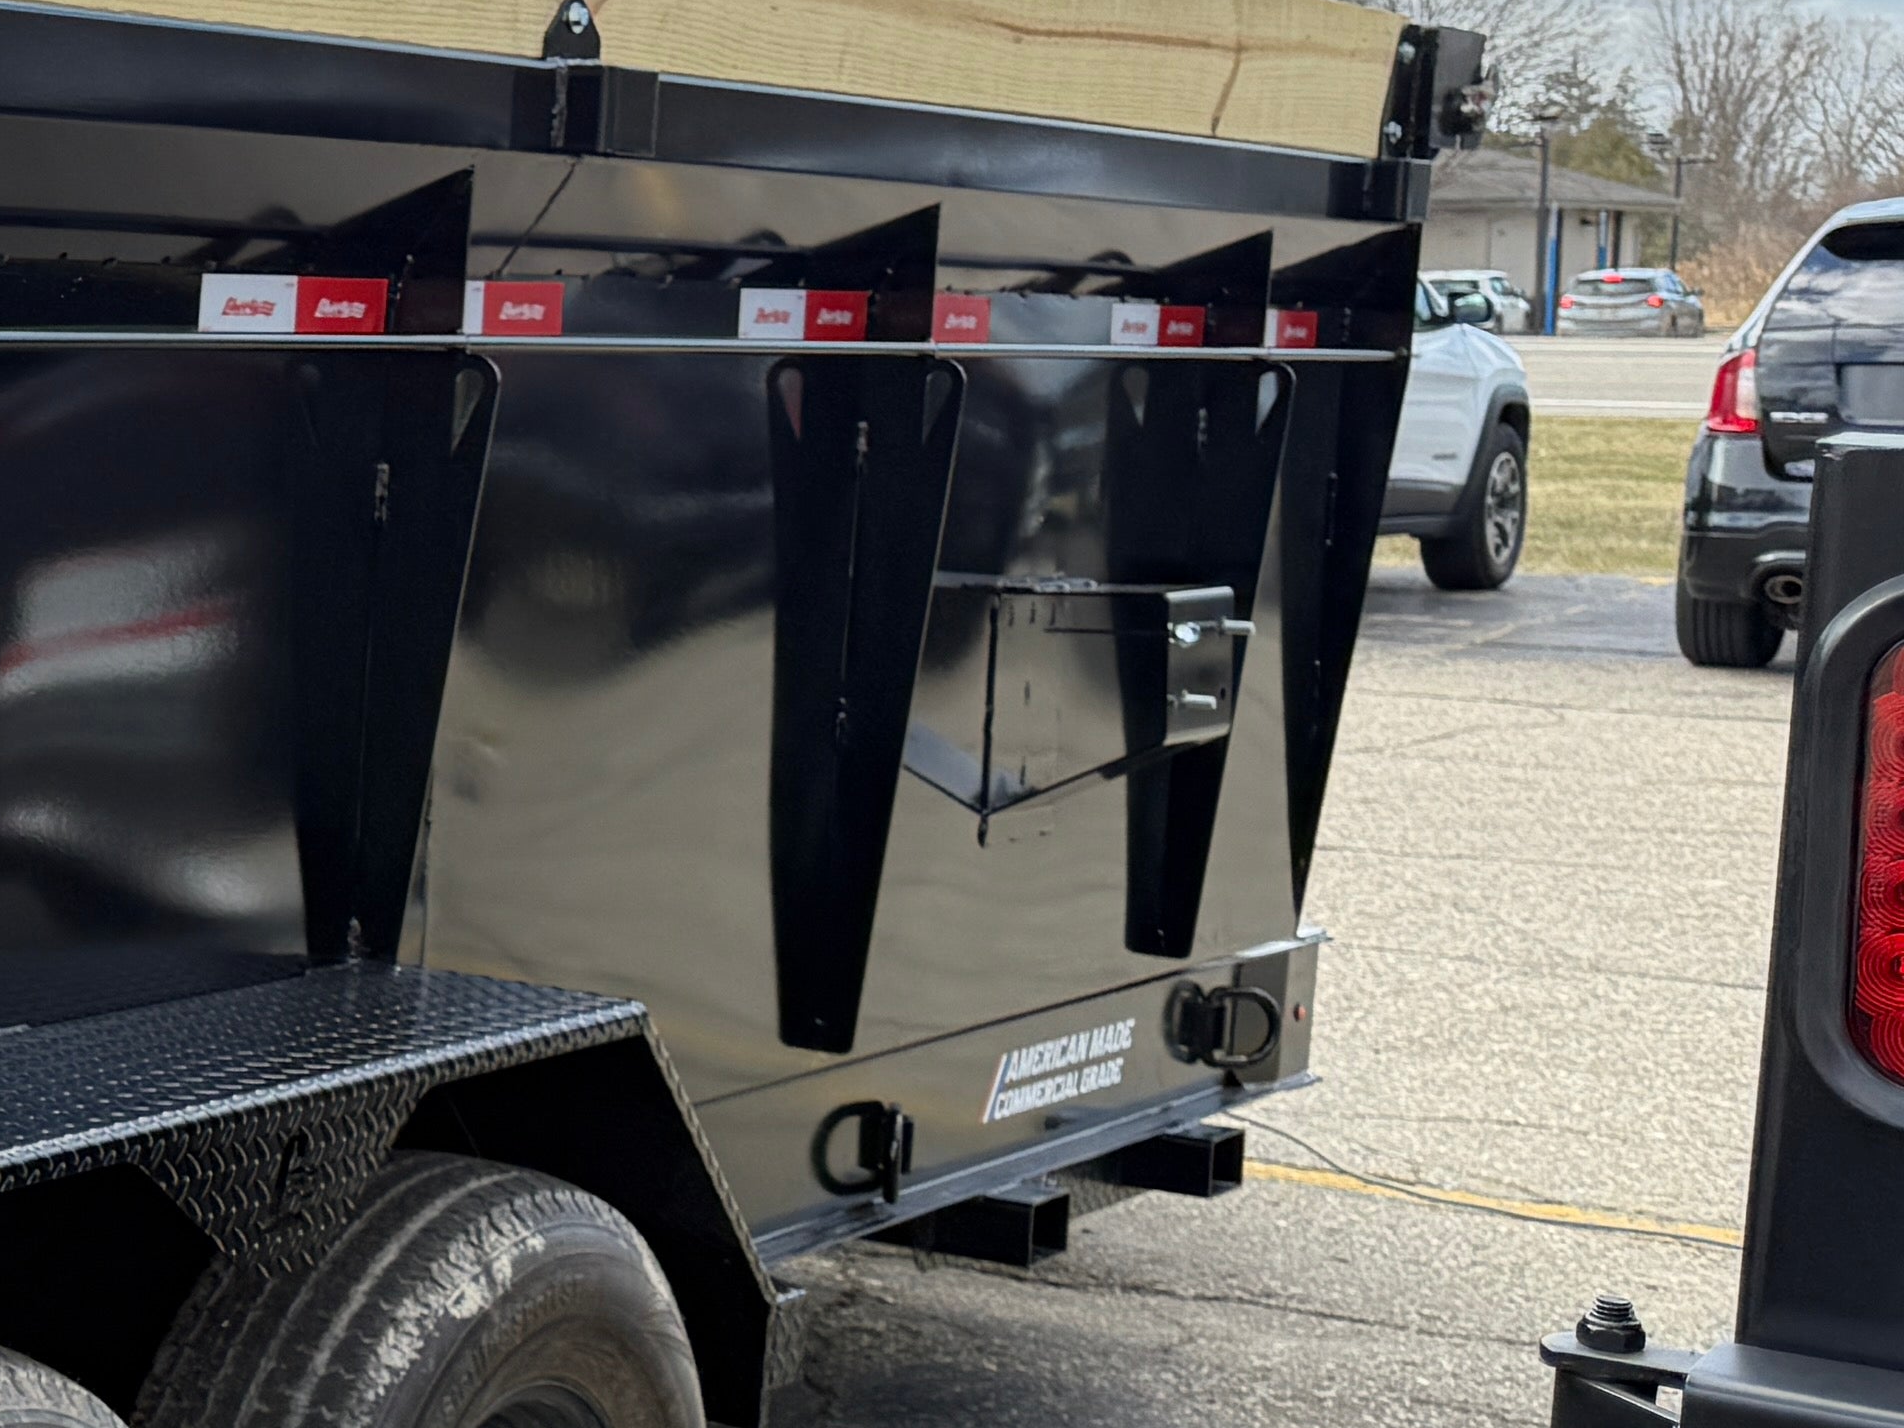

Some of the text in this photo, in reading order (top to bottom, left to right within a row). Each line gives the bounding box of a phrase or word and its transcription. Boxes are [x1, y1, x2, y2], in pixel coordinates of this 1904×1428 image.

[1004, 1018, 1136, 1084] AMERICAN MADE
[994, 1070, 1079, 1121] COMMERCIAL
